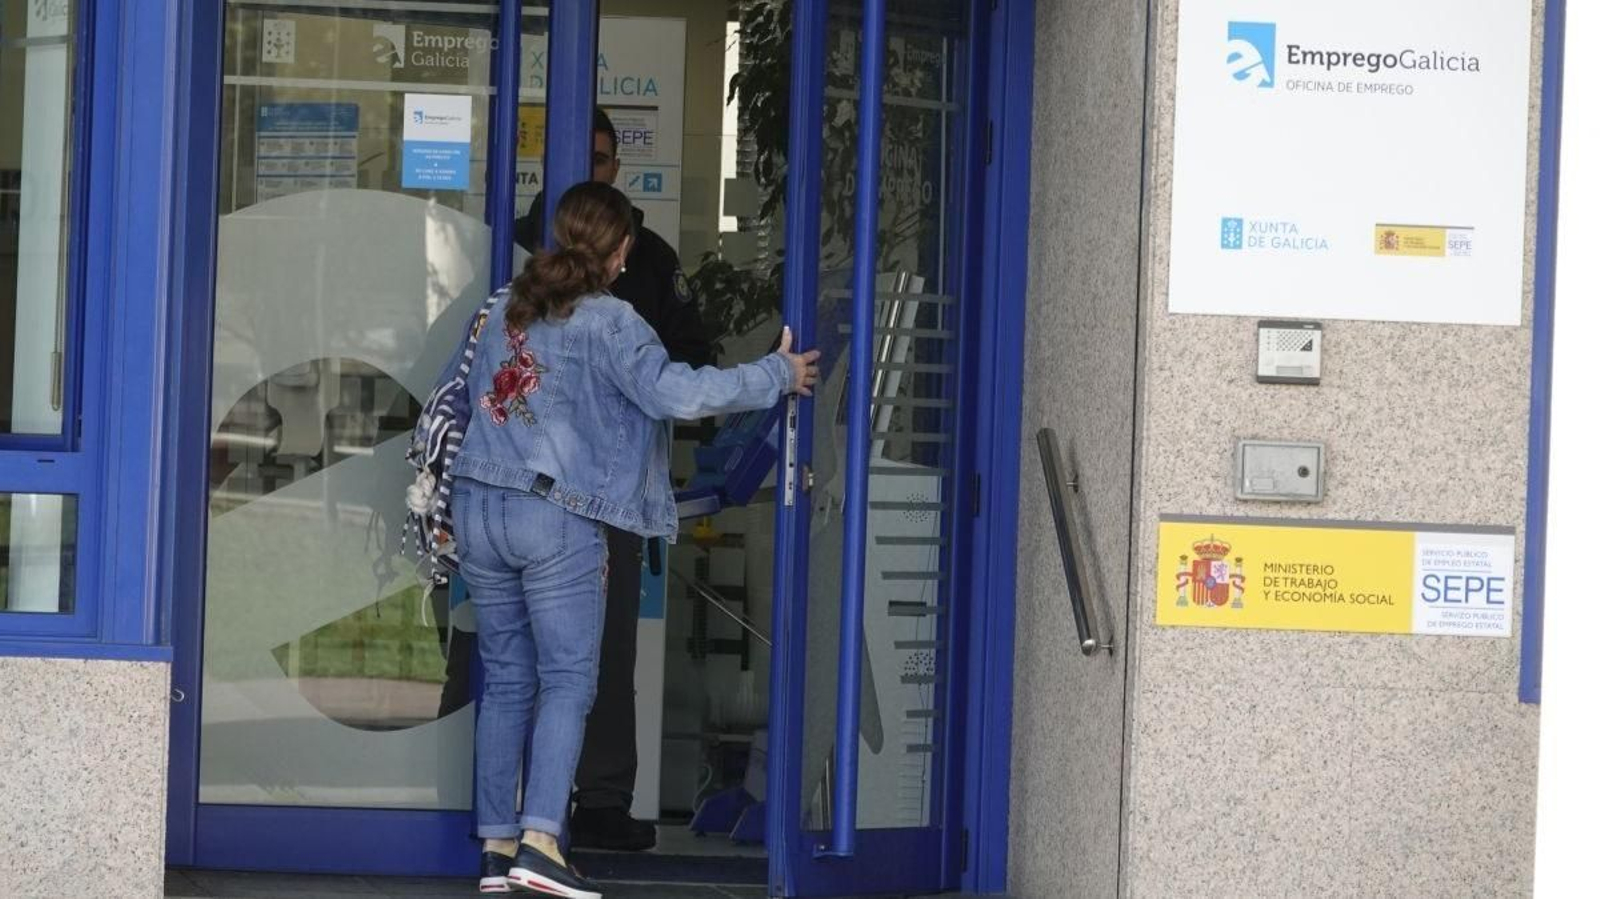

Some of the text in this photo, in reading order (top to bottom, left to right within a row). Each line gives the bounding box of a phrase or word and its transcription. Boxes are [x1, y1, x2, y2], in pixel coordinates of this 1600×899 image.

[412, 31, 499, 52] Emprego
[411, 51, 469, 67] Galicia
[1286, 44, 1480, 73] EmpregoGalicia
[599, 76, 658, 96] LICIA
[1286, 79, 1414, 95] OFICINA DE EMPREGO
[616, 129, 653, 145] SEPE
[1249, 221, 1298, 234] XUNTA
[1248, 235, 1329, 251] DE GALICIA
[1448, 239, 1473, 250] SEPE
[1263, 562, 1335, 576] MINISTERIO
[1263, 576, 1338, 592] DE TRABAJO
[1421, 573, 1505, 605] SEPE
[1263, 590, 1395, 606] Y ECONOMÍA SOCIAL
